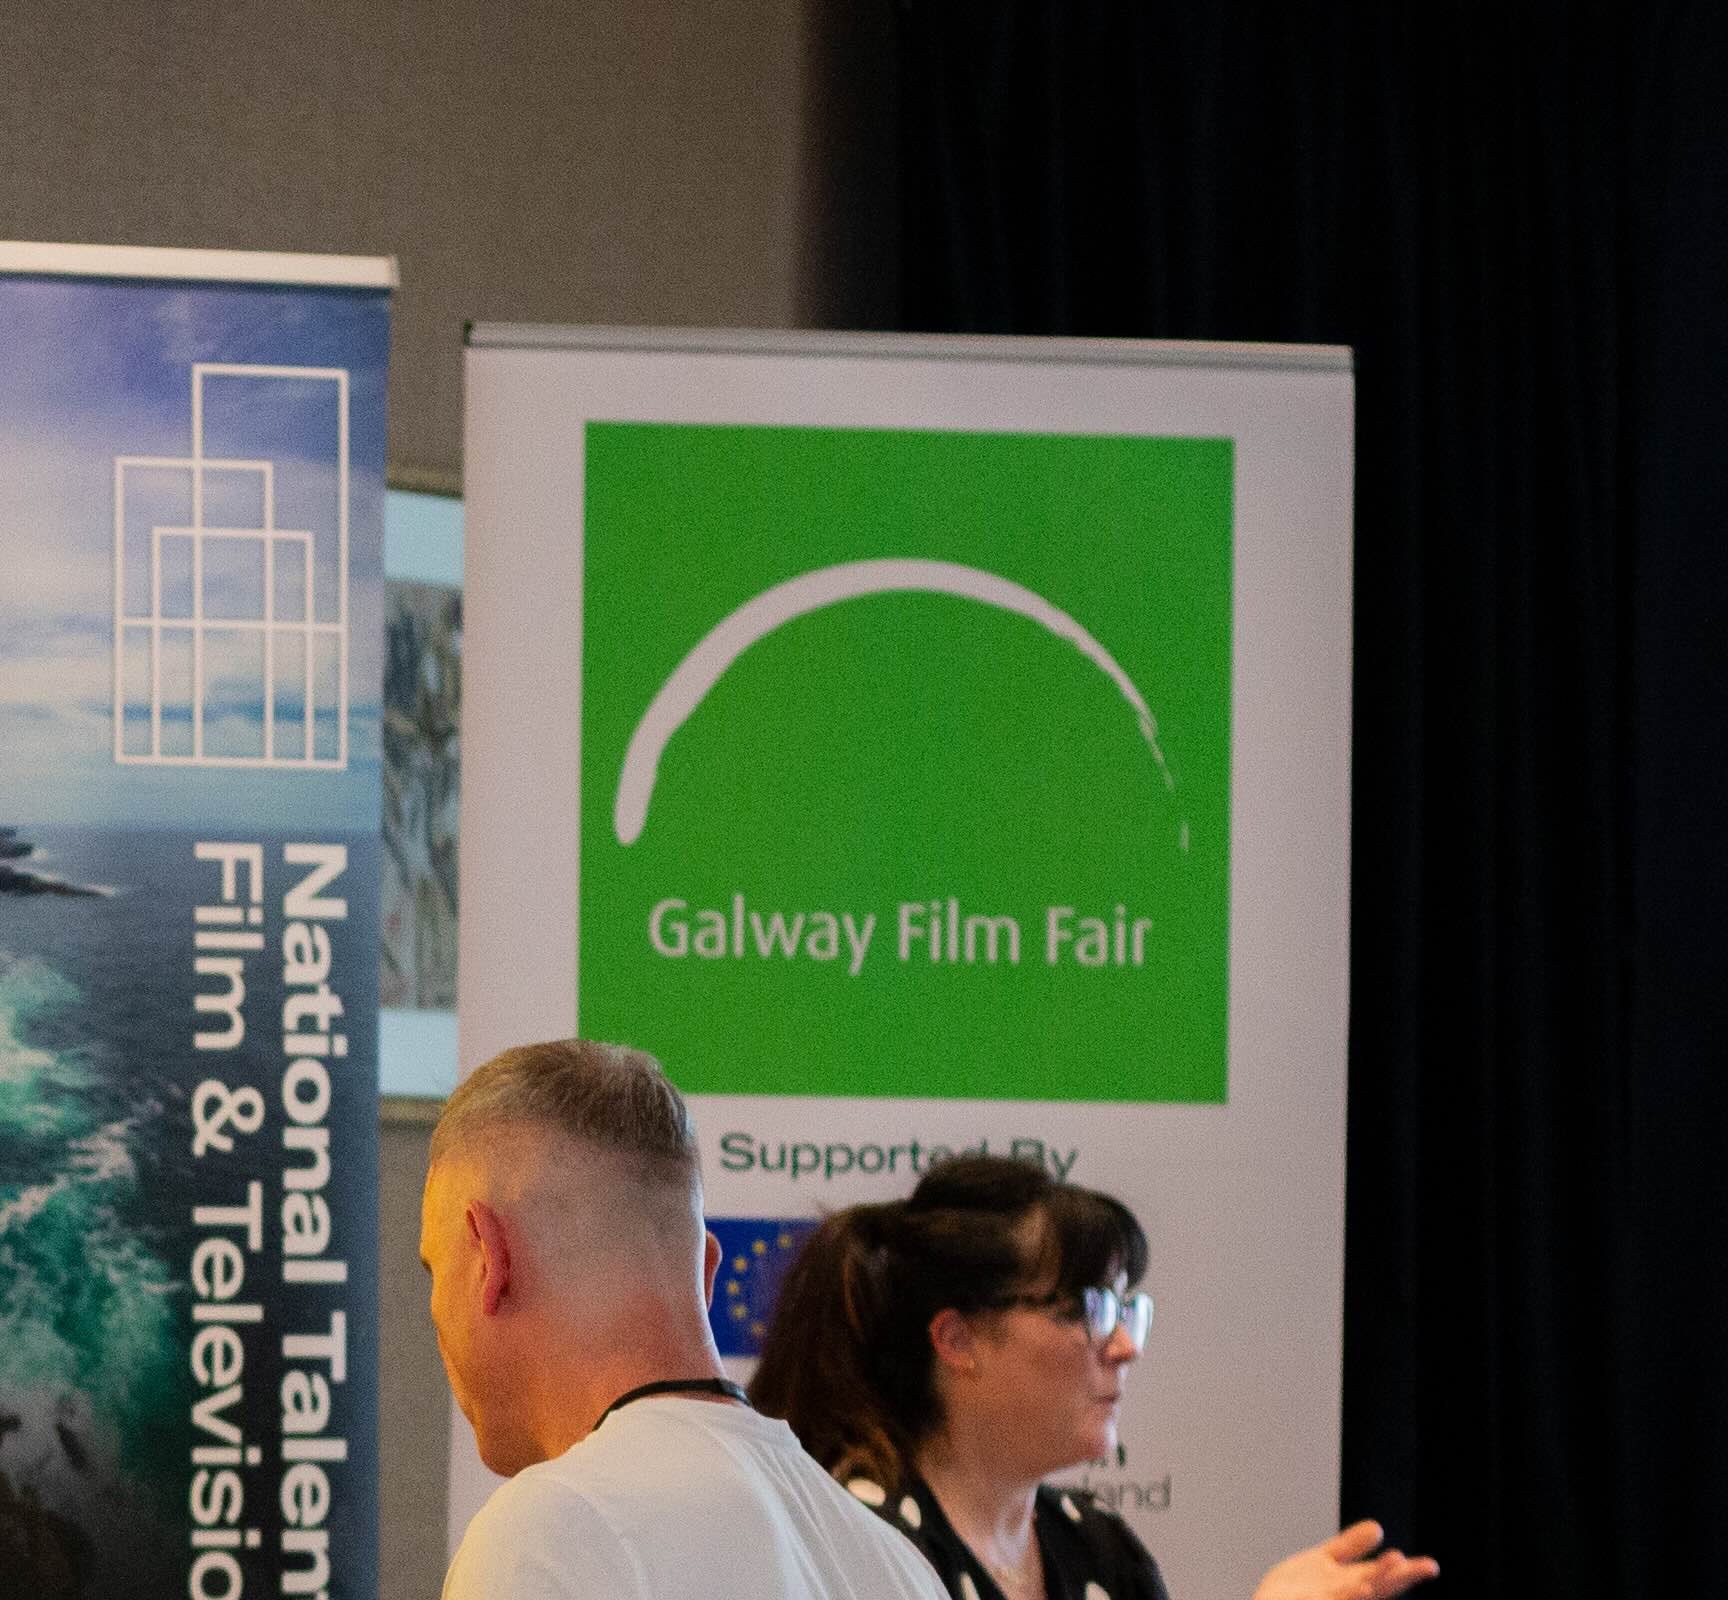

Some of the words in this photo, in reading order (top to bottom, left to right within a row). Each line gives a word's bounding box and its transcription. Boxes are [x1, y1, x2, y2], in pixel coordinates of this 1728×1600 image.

[193, 843, 264, 1050] Film
[649, 894, 876, 975] Galway
[897, 898, 1021, 964] Film
[1045, 904, 1152, 967] Fair
[192, 1078, 265, 1156] &
[283, 843, 348, 1284] National
